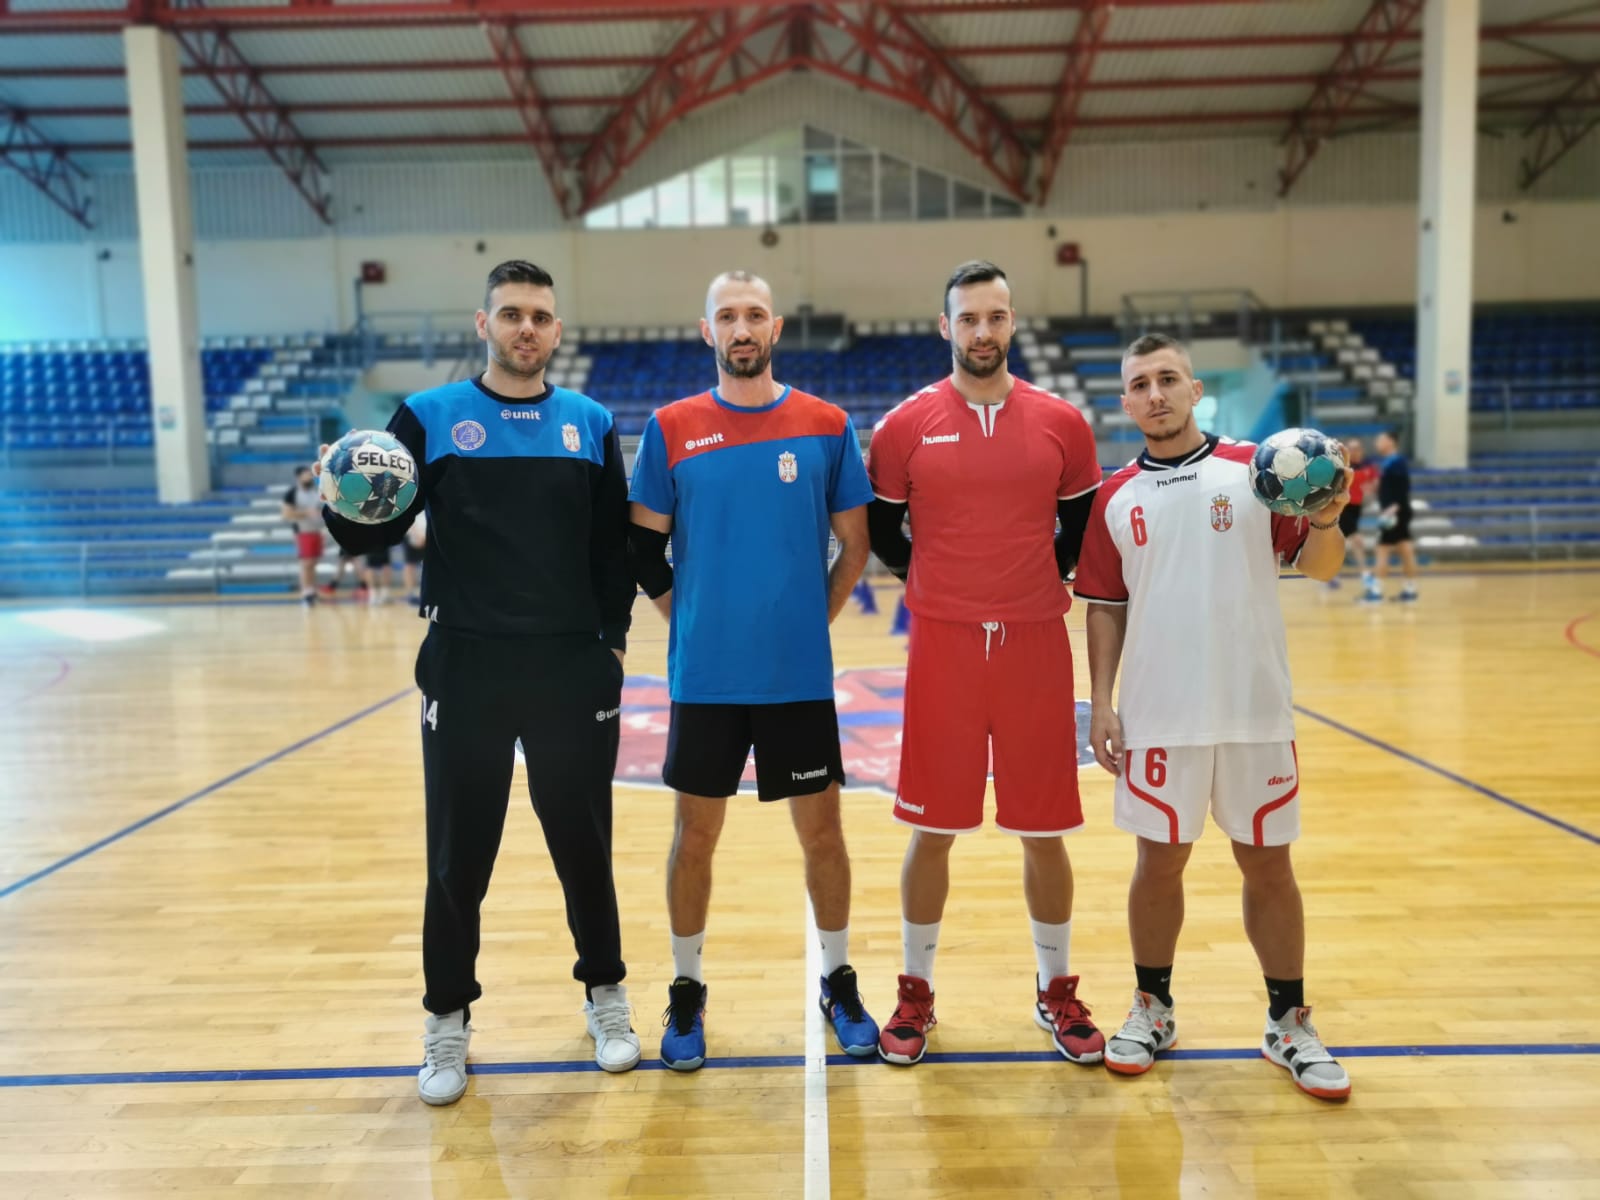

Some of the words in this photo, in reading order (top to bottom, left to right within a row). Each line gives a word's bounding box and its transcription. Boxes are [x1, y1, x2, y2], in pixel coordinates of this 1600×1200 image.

[922, 432, 960, 445] hummel
[357, 451, 412, 474] SELECT
[1156, 471, 1197, 488] hummel
[1130, 505, 1148, 547] 6
[791, 765, 828, 781] hummel
[1145, 747, 1168, 788] 6
